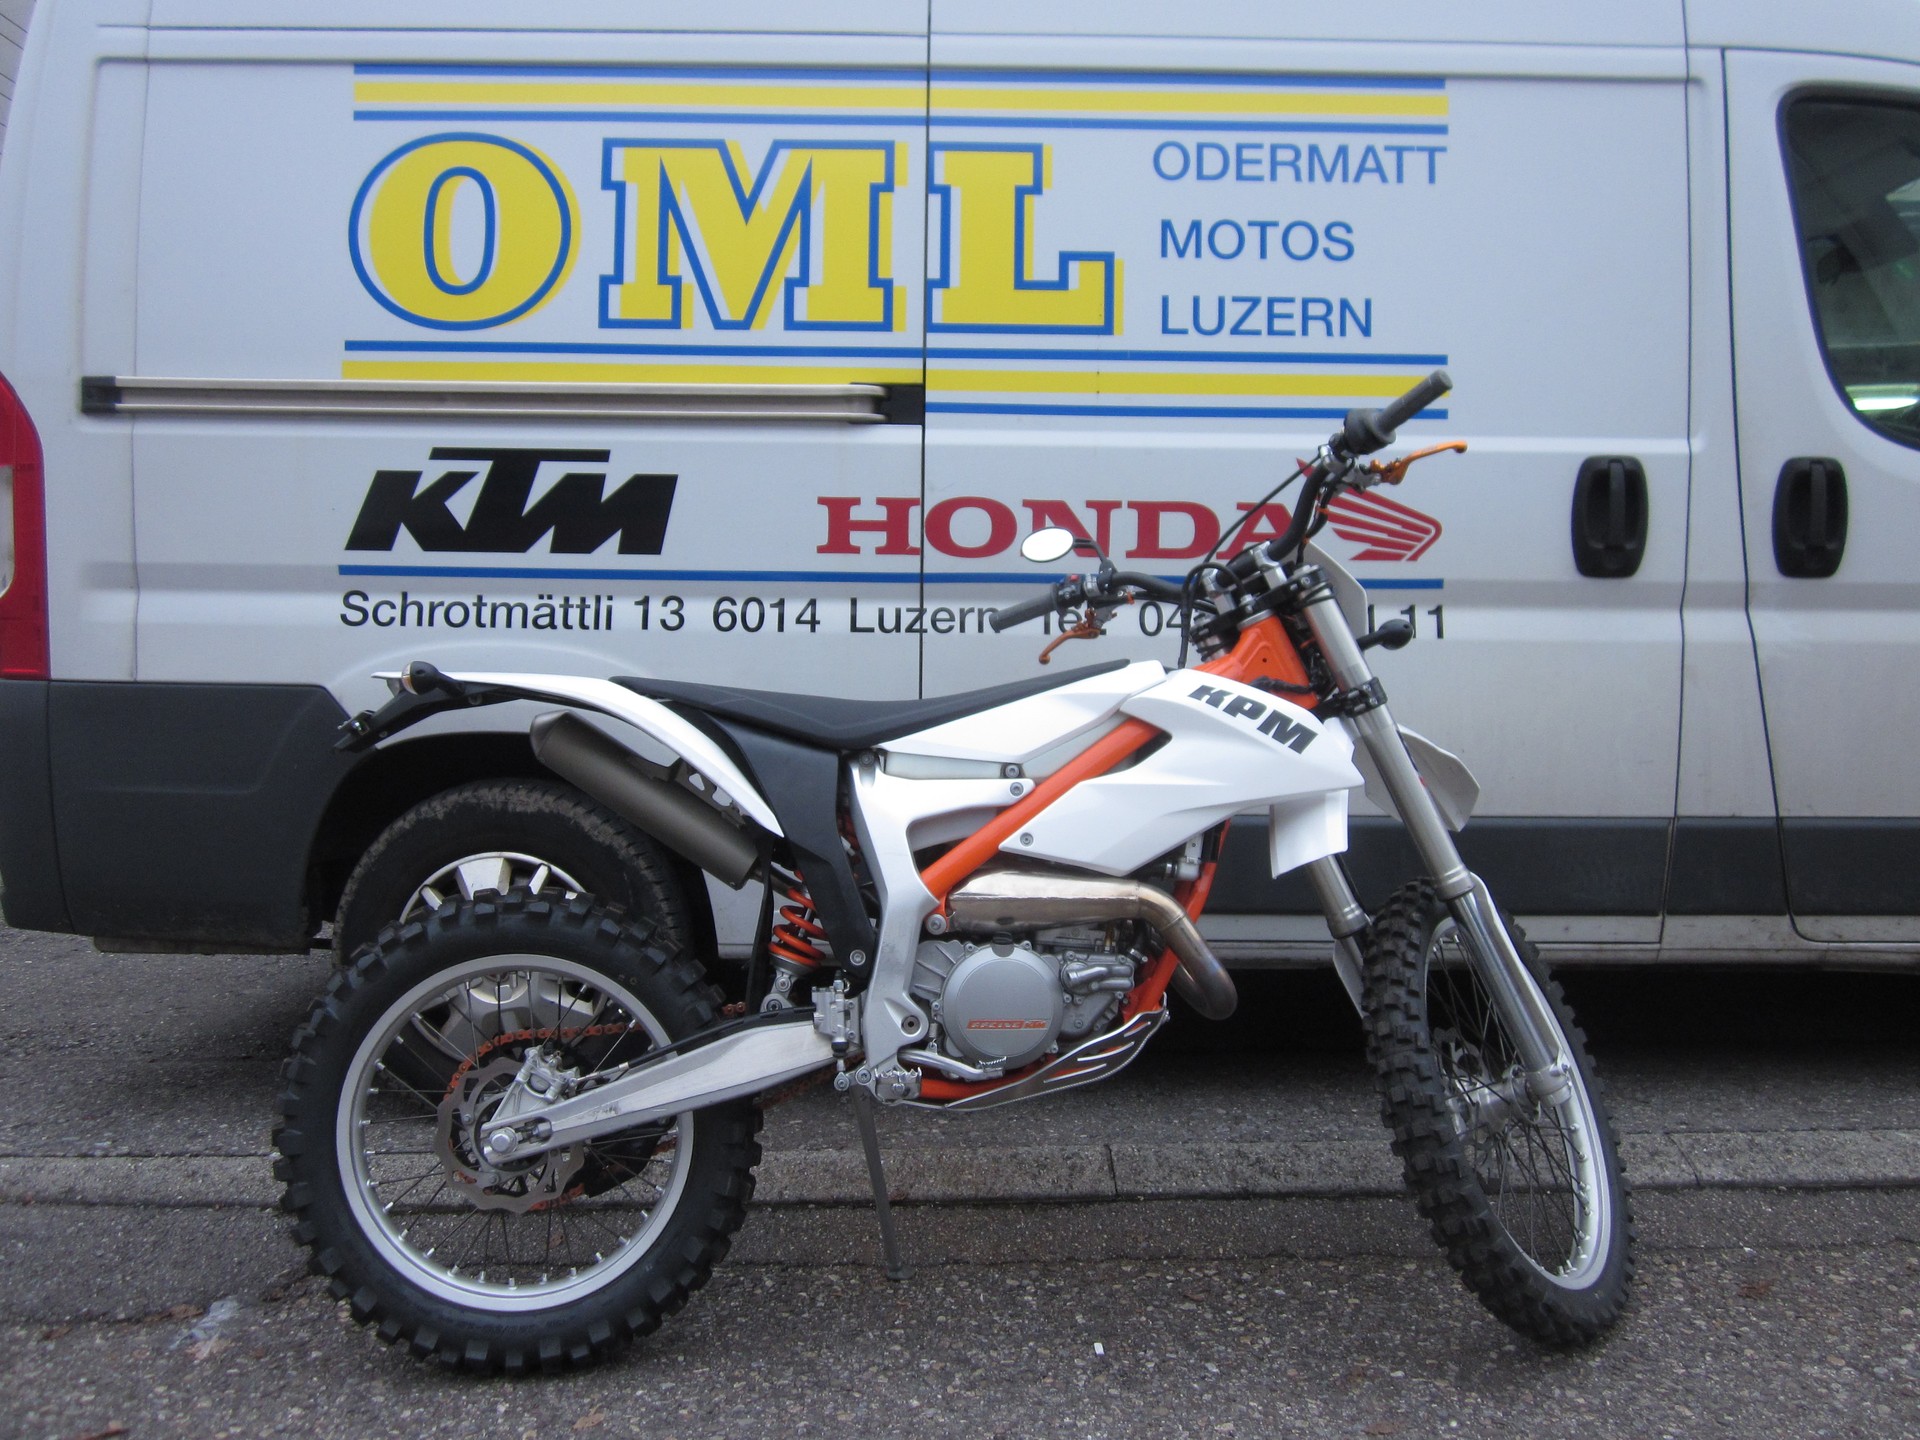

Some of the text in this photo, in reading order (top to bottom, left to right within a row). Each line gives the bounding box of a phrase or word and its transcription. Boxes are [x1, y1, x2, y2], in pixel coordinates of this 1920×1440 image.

[1152, 140, 1447, 185] ODERMATT
[348, 131, 1124, 335] OML
[1160, 219, 1355, 262] MOTOS
[1160, 294, 1372, 338] LUZERN
[344, 446, 679, 555] KTM
[816, 495, 1294, 560] HONDA
[339, 590, 613, 631] Schrotmättli
[634, 596, 685, 632] 13
[712, 596, 821, 633] 6014
[1187, 684, 1319, 755] KPM
